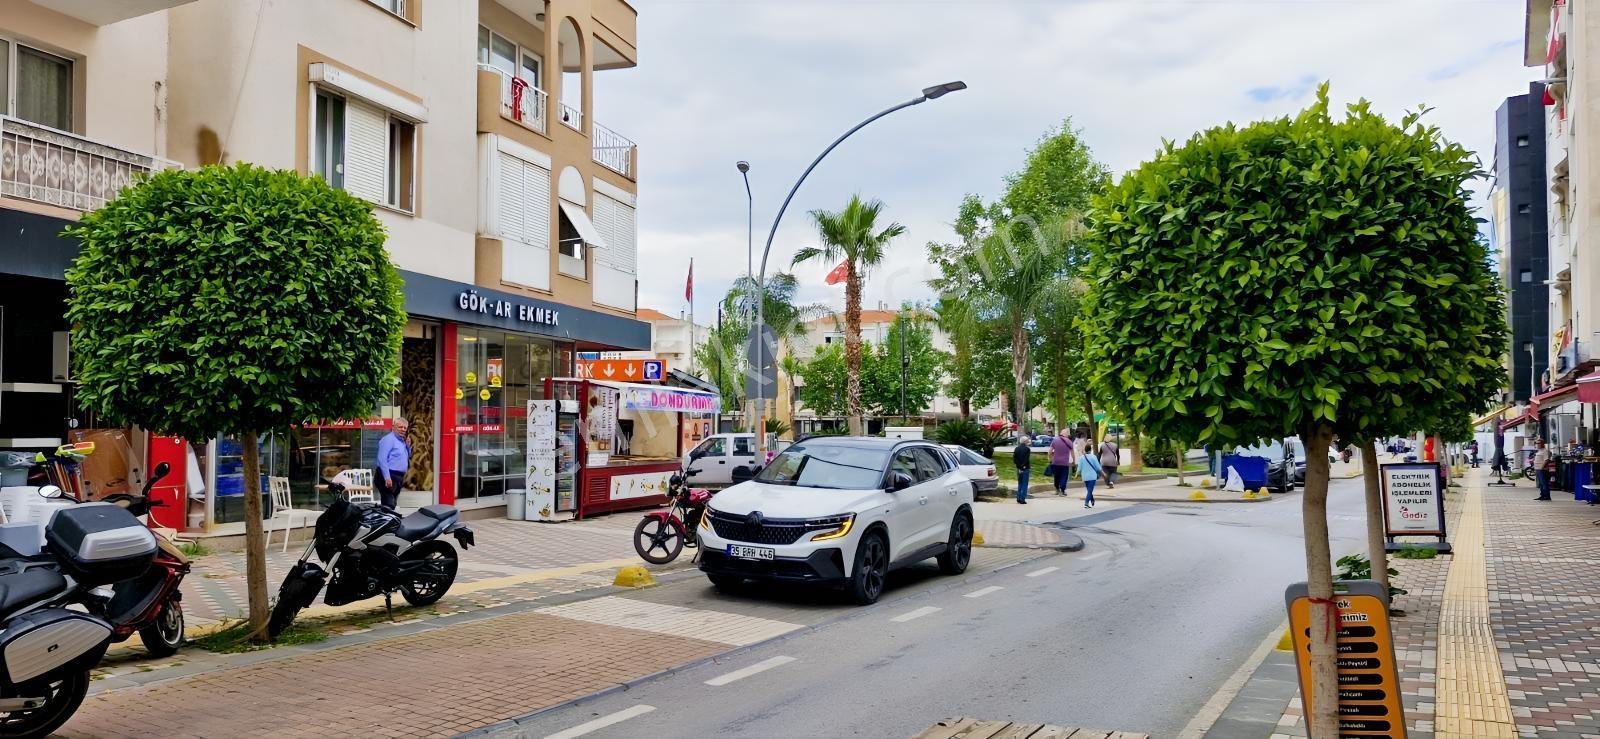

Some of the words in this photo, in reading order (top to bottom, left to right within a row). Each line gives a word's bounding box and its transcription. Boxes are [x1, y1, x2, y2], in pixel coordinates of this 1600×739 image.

[459, 289, 512, 318] GÖK-AR
[519, 304, 560, 327] EKMEK
[646, 362, 659, 378] P
